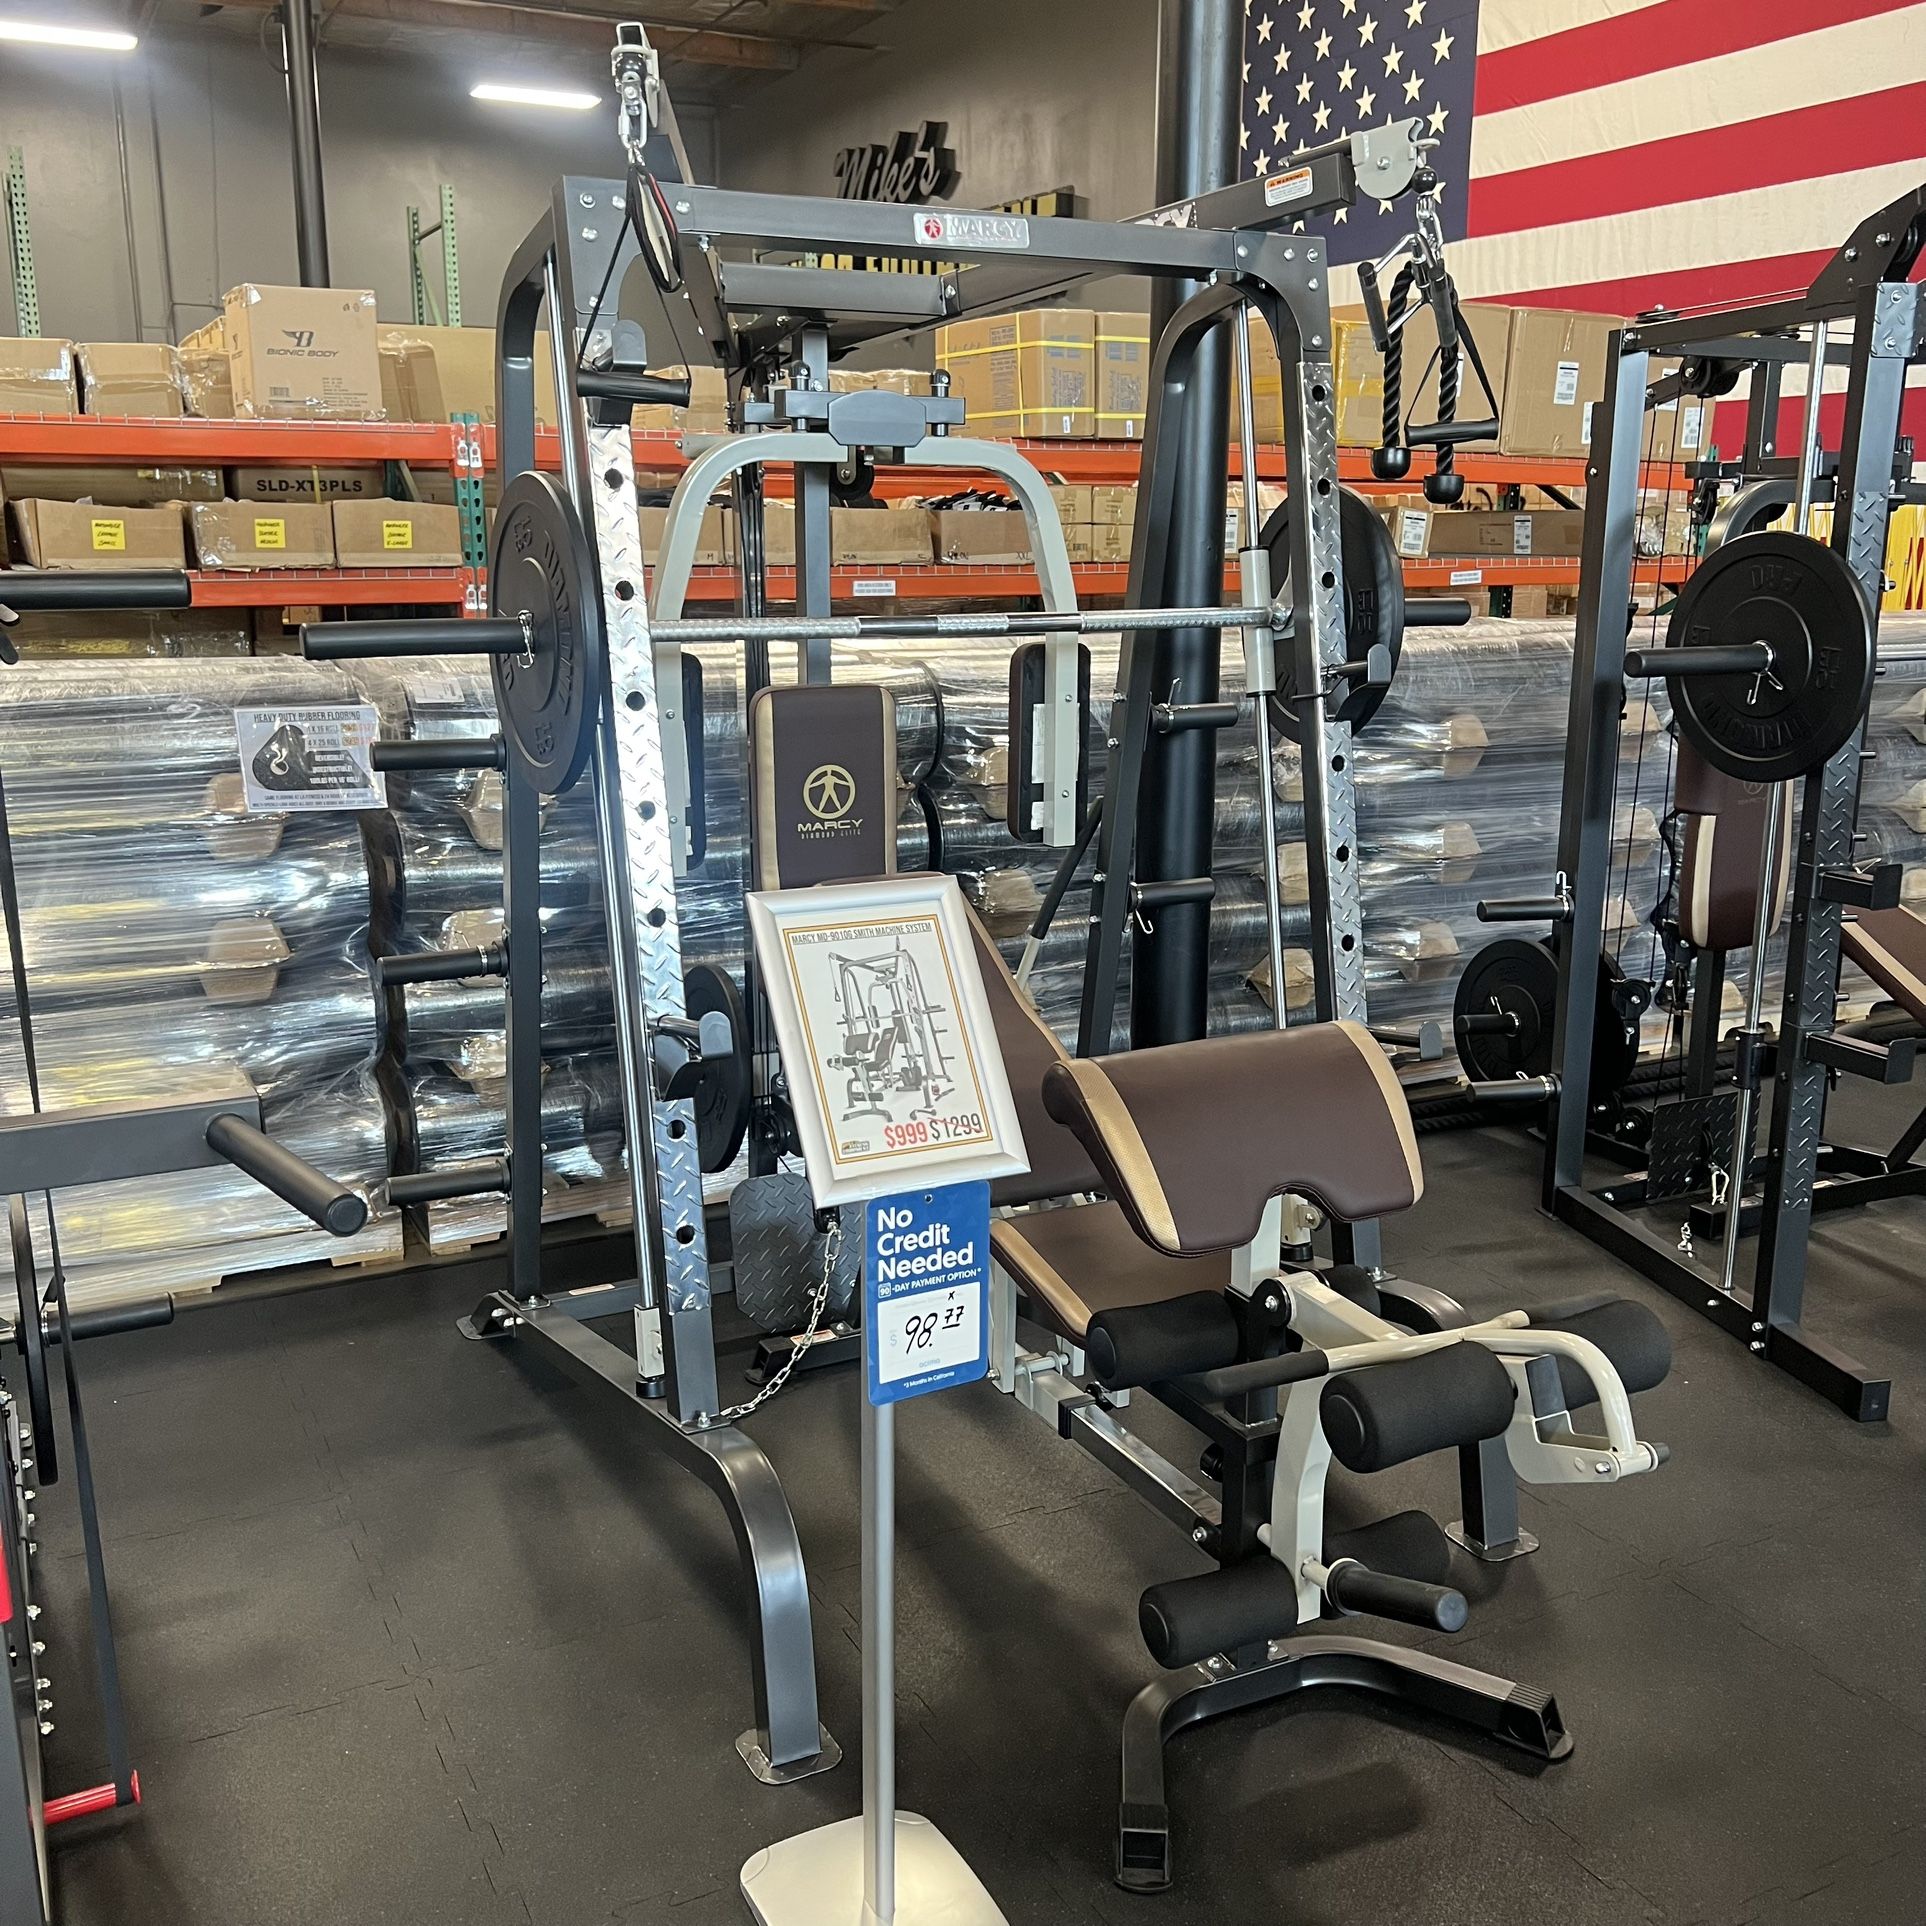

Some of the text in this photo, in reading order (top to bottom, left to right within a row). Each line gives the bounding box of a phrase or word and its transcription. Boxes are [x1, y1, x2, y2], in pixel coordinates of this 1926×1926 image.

[267, 348, 340, 358] BIONIC BODY
[254, 710, 361, 723] HEAVY DUTY RUBBER FLOORING
[797, 818, 863, 832] MARCY
[791, 934, 816, 945] MARCY
[854, 927, 874, 938] SMITH
[875, 924, 904, 936] MACHINE
[905, 921, 932, 933] SYSTEM
[884, 1121, 928, 1148] $999
[929, 1113, 982, 1141] $1299
[877, 1207, 913, 1232] No
[877, 1223, 951, 1256] Credit
[878, 1241, 974, 1282] Needed
[911, 1274, 946, 1289] PAYMENT
[909, 1377, 928, 1388] Months
[933, 1371, 955, 1382] California
